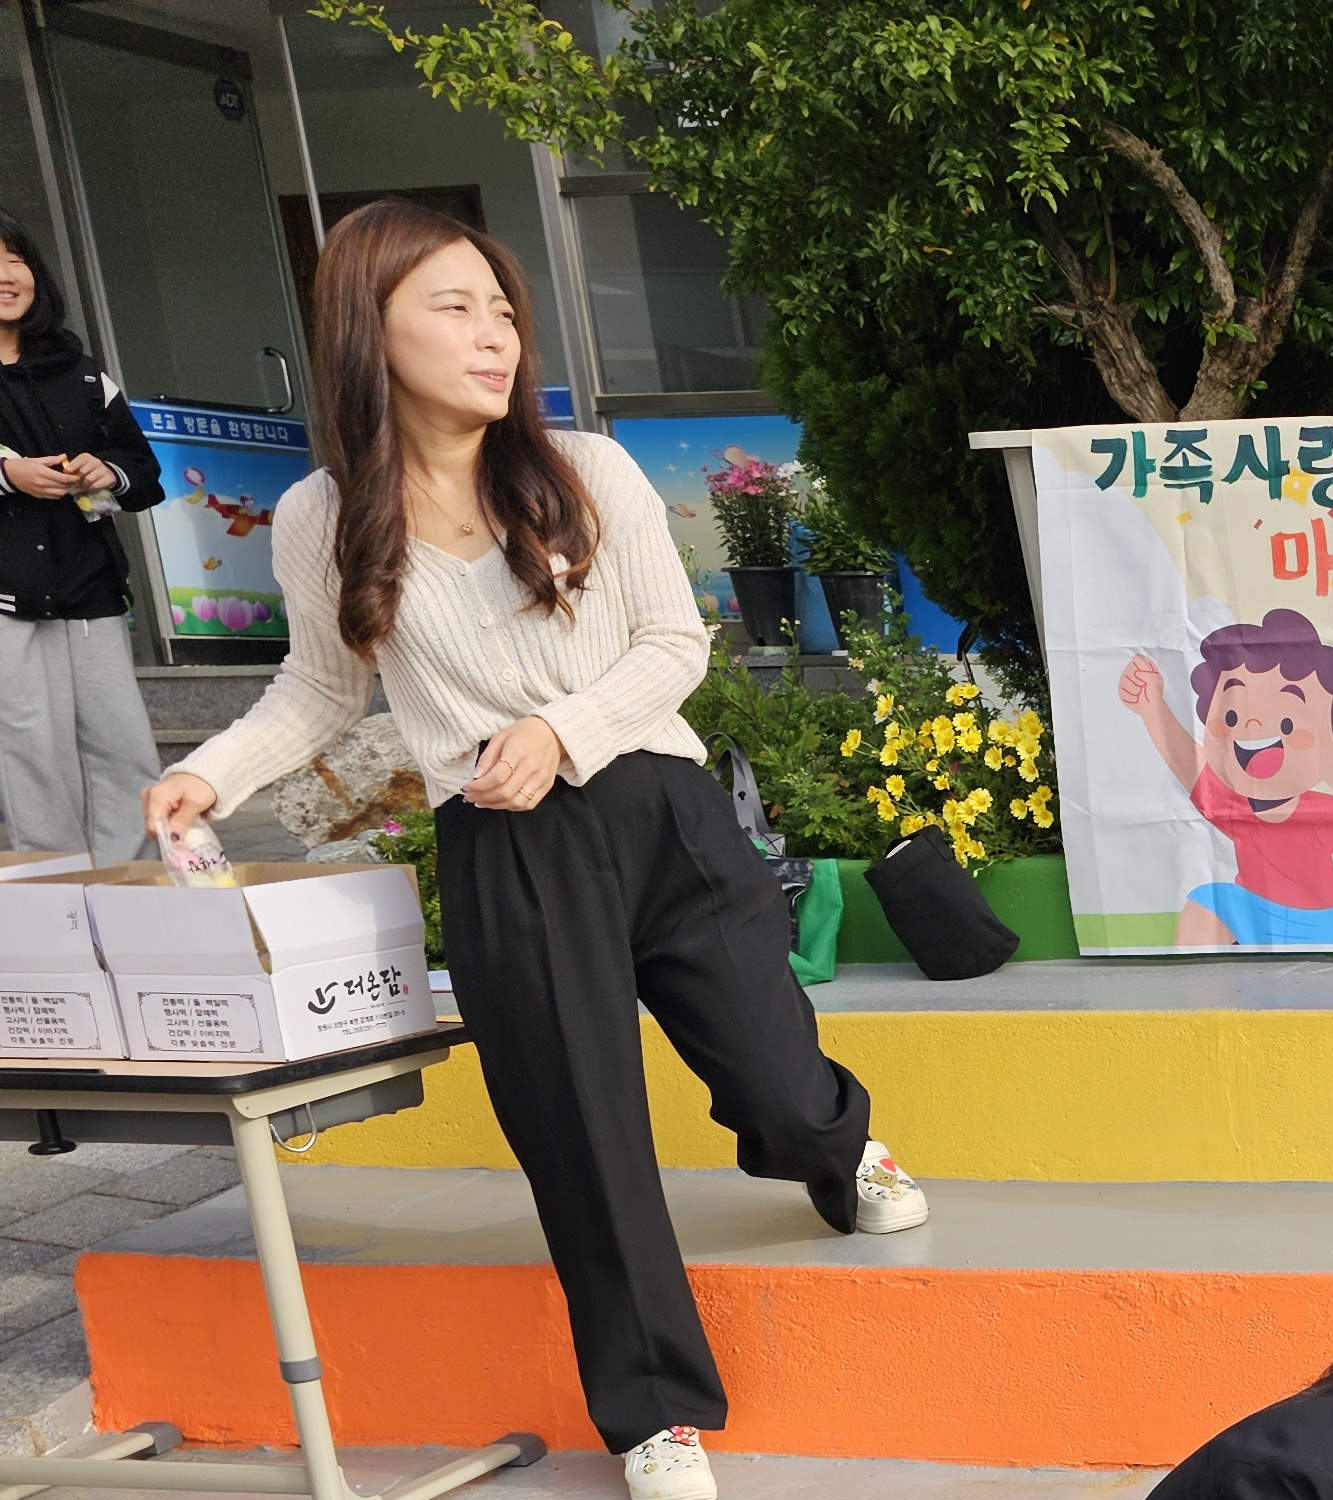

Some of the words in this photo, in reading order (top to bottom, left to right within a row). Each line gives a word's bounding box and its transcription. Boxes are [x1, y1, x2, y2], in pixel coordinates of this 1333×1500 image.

[150, 412, 177, 431] 본교
[182, 416, 222, 435] 방문을
[227, 420, 289, 442] 환영합니다
